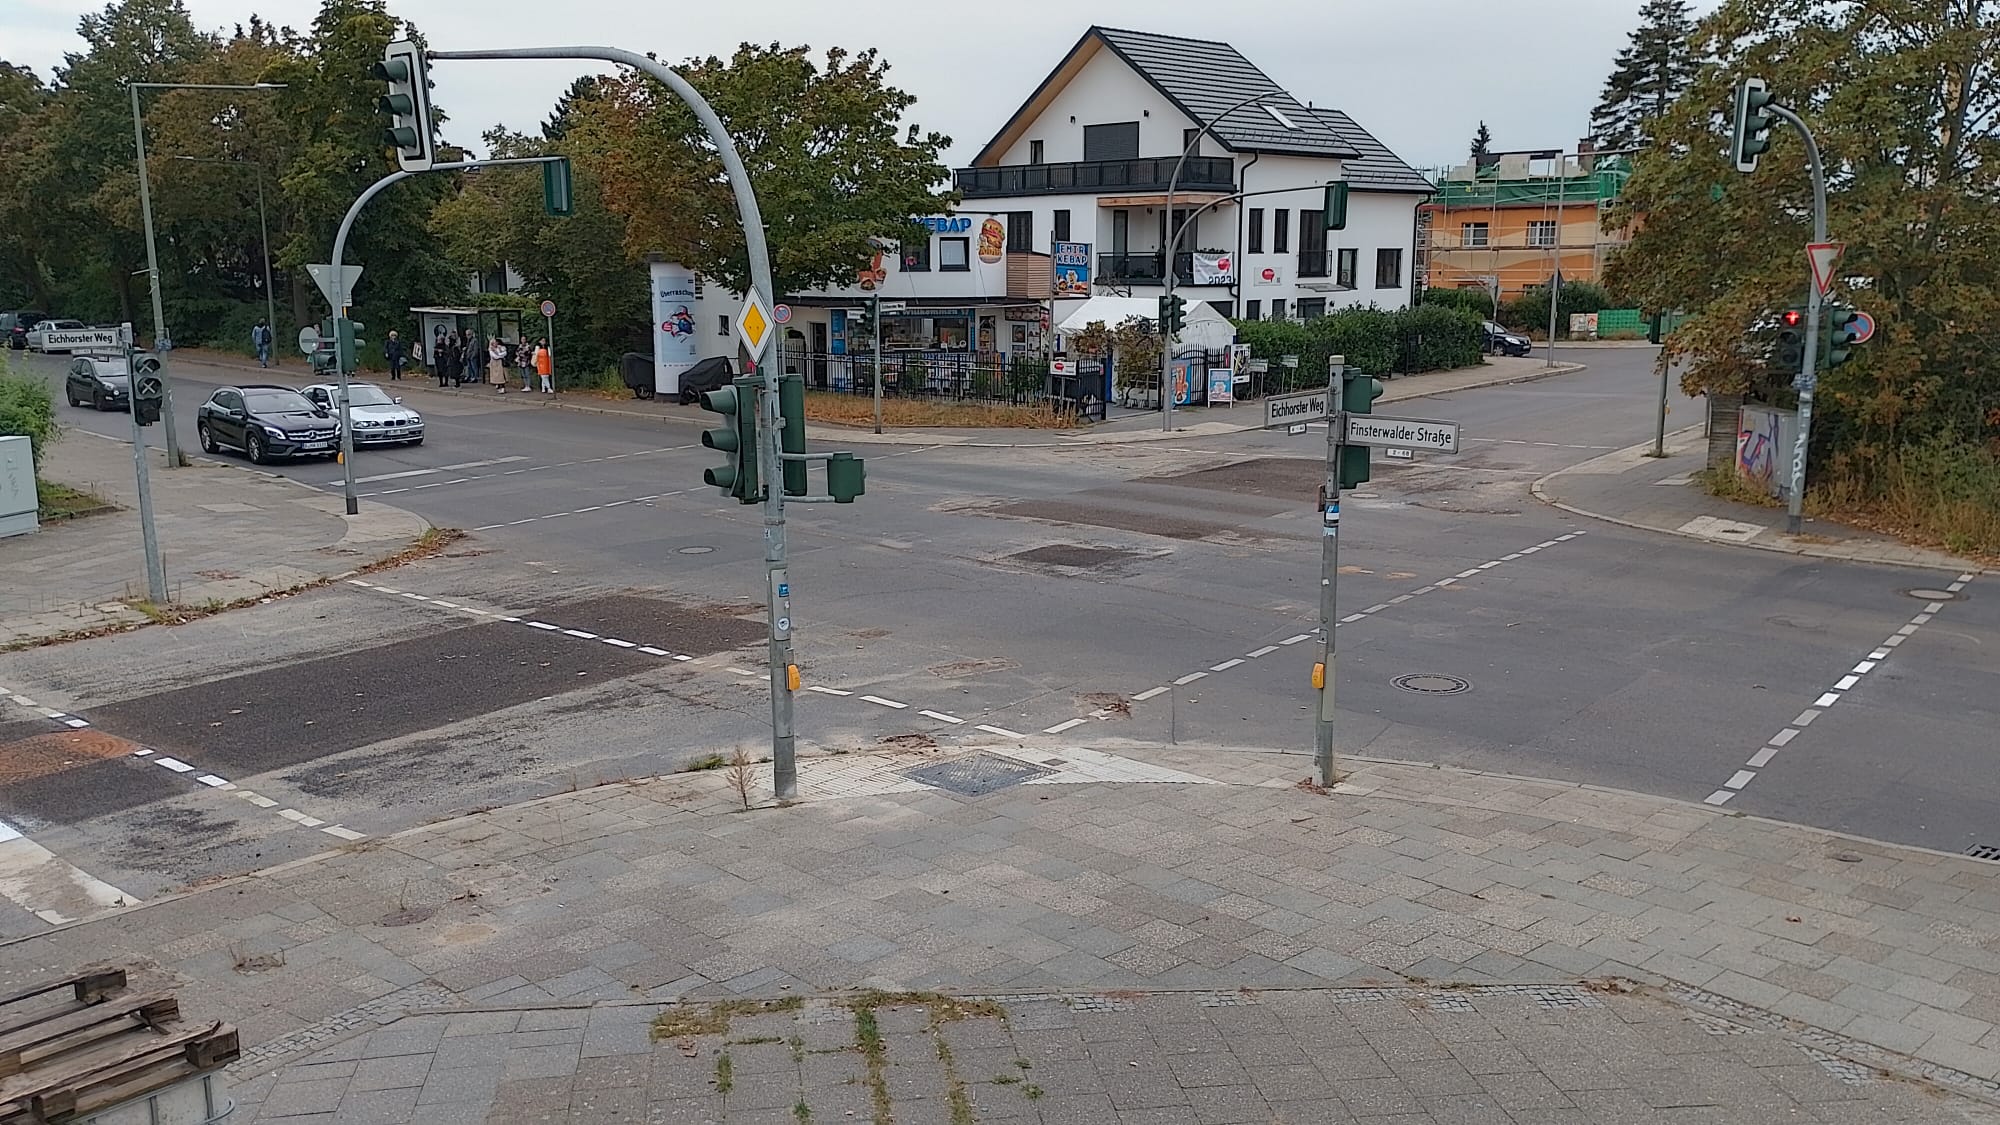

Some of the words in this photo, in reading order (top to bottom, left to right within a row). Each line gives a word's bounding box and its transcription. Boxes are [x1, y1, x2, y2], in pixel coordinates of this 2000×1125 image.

[1060, 244, 1085, 254] EMIR
[1057, 254, 1087, 265] KEBAP
[1208, 275, 1232, 285] 2023
[48, 333, 93, 344] Eichhorster
[94, 333, 113, 344] Weg
[1271, 400, 1309, 418] Eichhorster
[1309, 397, 1324, 414] Weg
[1350, 422, 1415, 441] Finsterwalder
[1416, 427, 1452, 447] Straße
